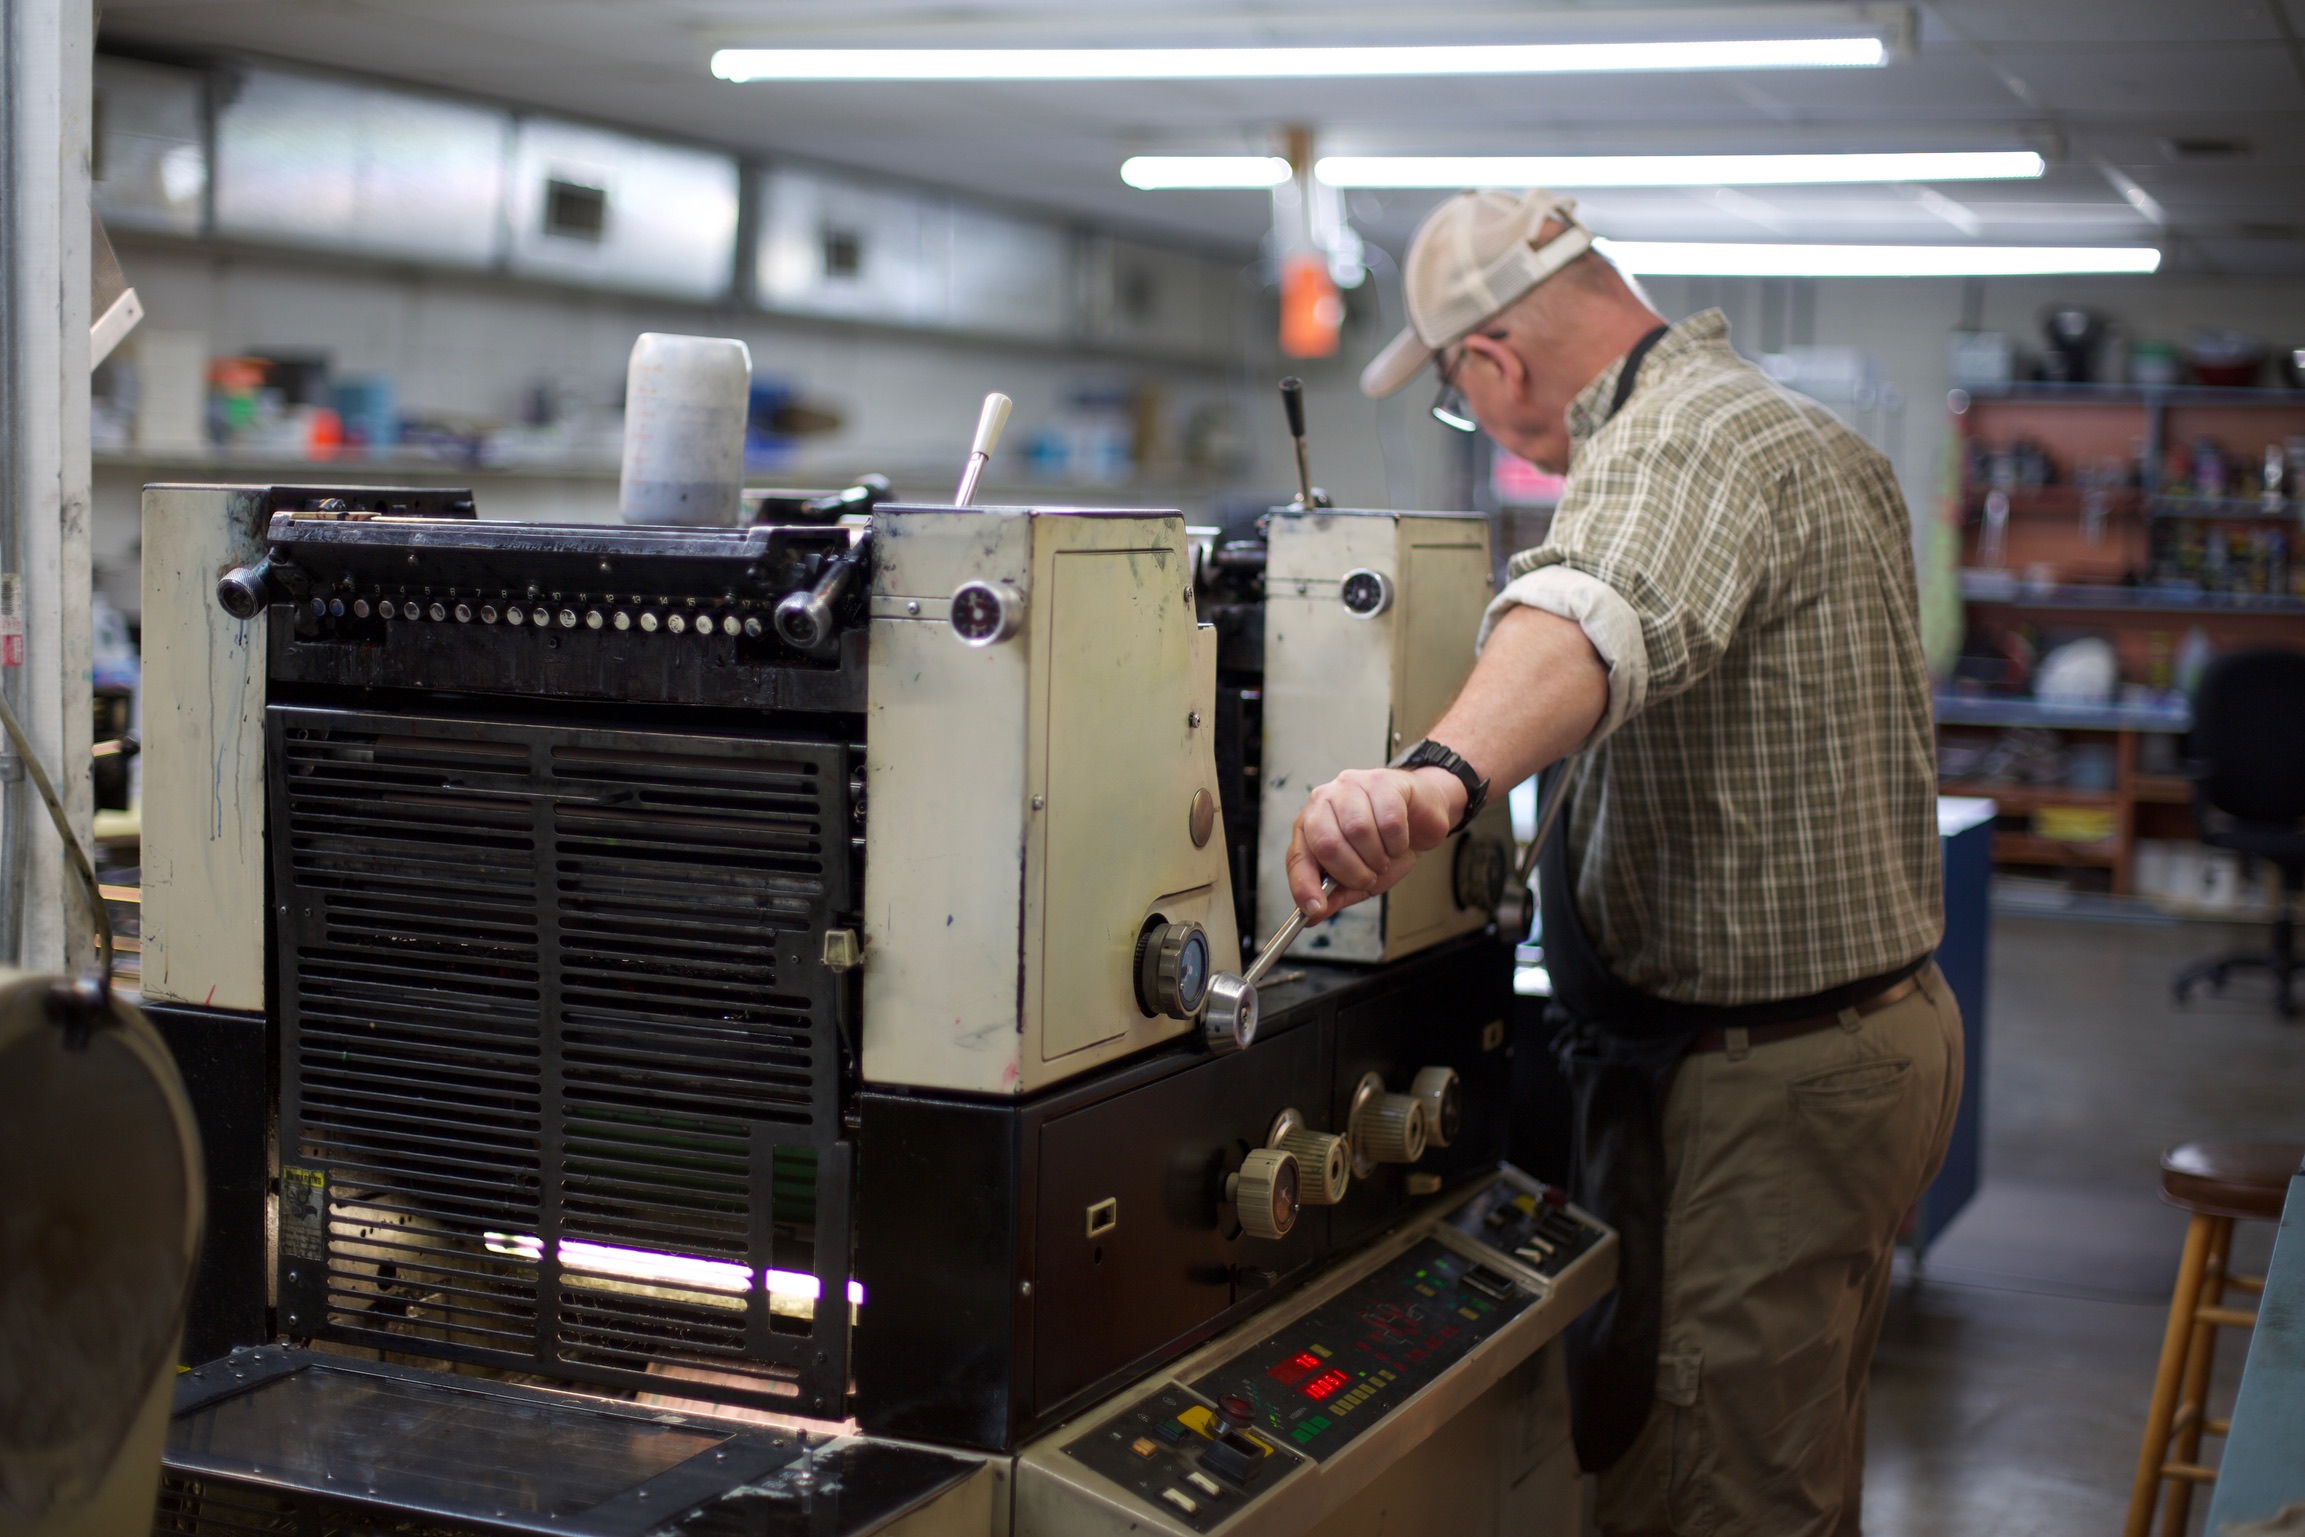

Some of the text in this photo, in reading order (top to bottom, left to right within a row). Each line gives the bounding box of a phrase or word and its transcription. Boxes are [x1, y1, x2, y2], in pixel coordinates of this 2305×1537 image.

[374, 584, 380, 593] 3
[400, 585, 406, 594] 4
[424, 586, 431, 595] 5
[449, 587, 456, 596] 6
[475, 588, 481, 597] 7
[501, 589, 507, 599] 8
[552, 592, 561, 601] 10
[580, 593, 587, 602] 11
[605, 594, 614, 603] 12
[632, 595, 641, 604] 13
[659, 596, 668, 605] 14
[686, 597, 696, 606] 15
[741, 600, 751, 609] 17
[1306, 1369, 1347, 1399] 10051
